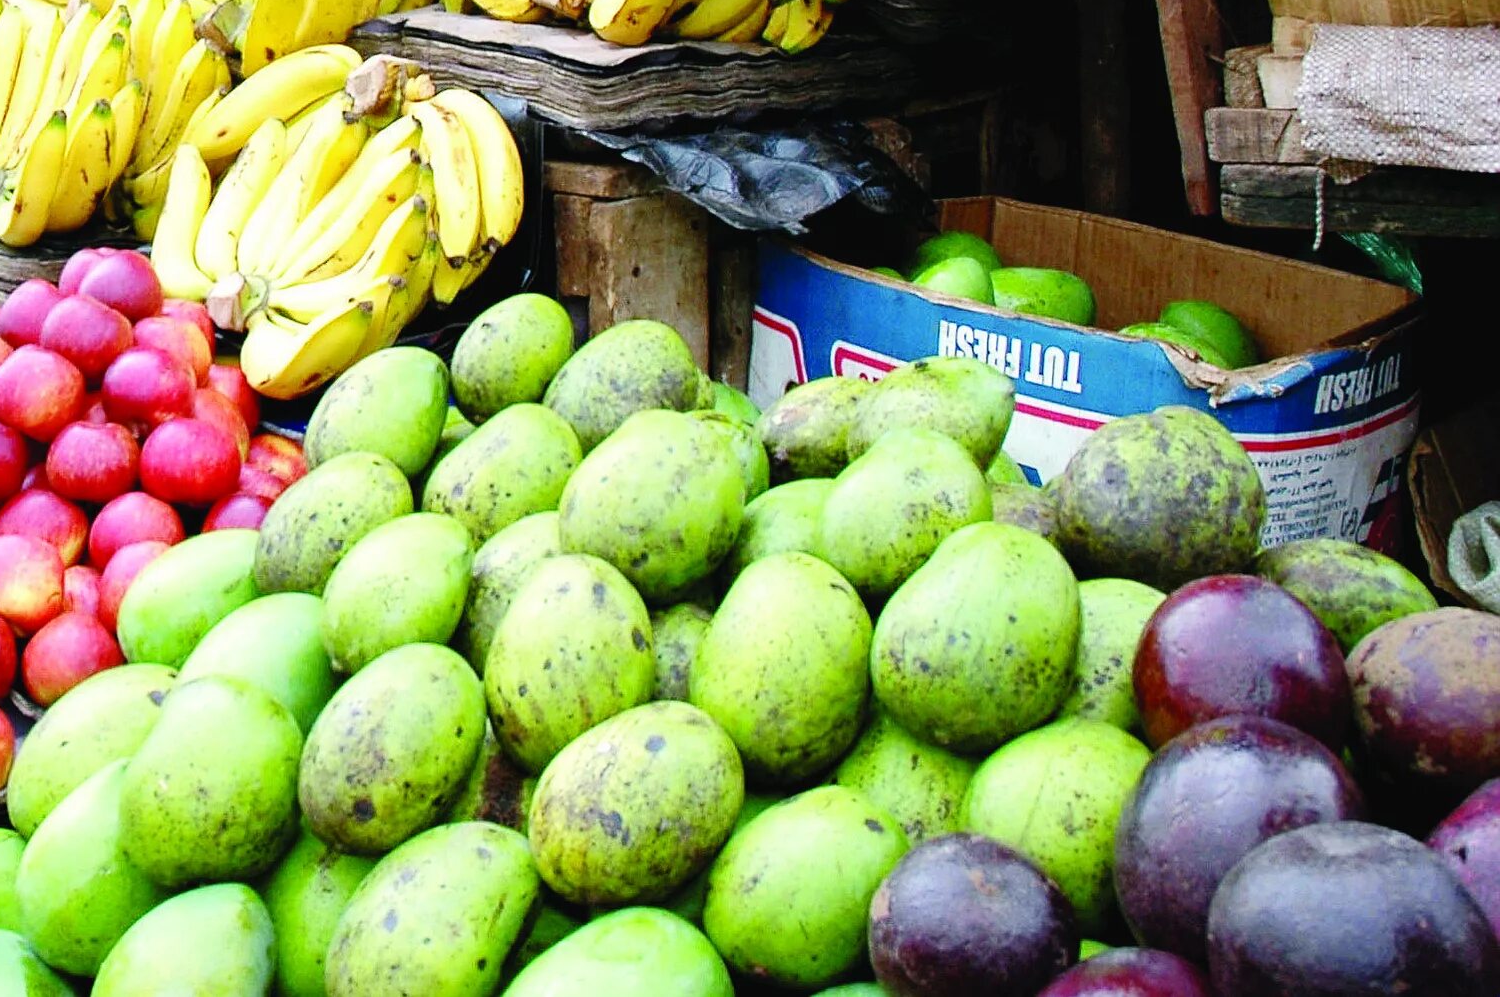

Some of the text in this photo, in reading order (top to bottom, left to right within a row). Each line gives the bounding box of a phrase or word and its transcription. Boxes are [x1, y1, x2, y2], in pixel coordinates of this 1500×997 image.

[938, 319, 1082, 393] TUT FRESH
[1314, 353, 1401, 414] TUT FRESH
